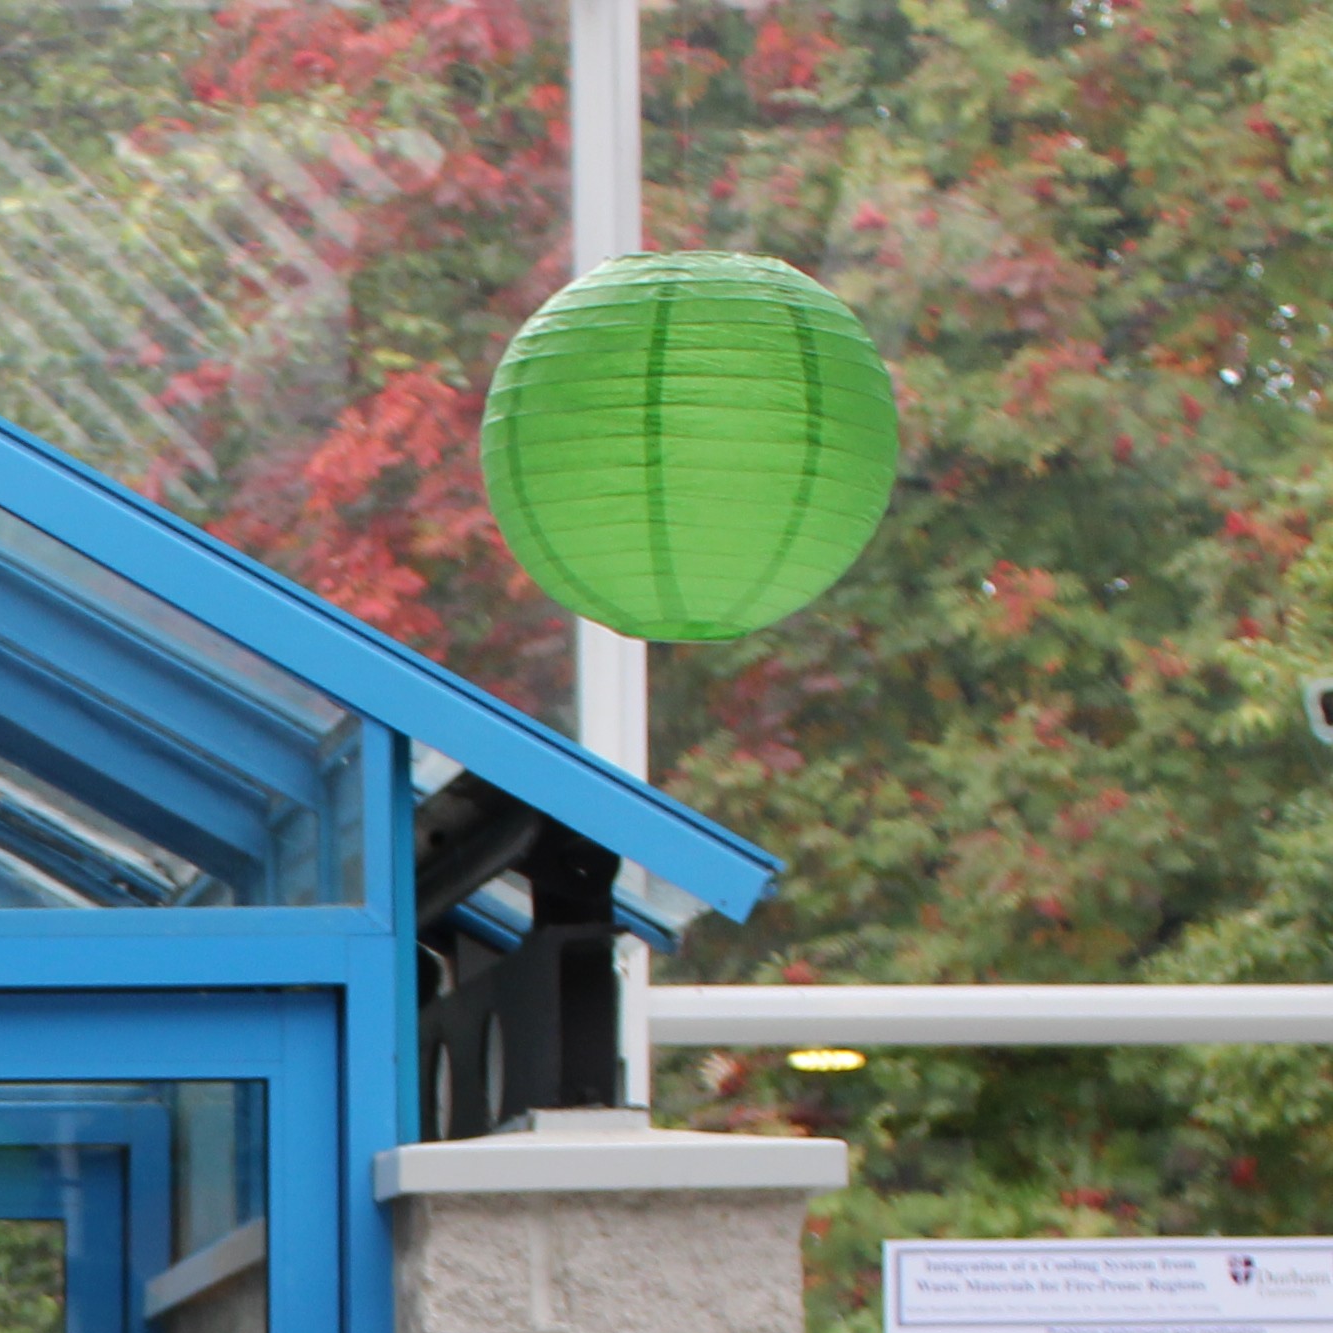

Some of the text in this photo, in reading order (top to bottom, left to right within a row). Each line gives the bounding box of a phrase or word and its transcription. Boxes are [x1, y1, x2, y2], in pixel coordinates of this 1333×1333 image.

[925, 1258, 1007, 1274] Integration
[1011, 1259, 1027, 1271] of
[1043, 1257, 1099, 1274] Cooling
[1104, 1259, 1156, 1274] System
[1161, 1258, 1196, 1270] from
[1260, 1268, 1331, 1284] Durham
[916, 1279, 1207, 1294] Waste Materials for Fire-Prone Regions
